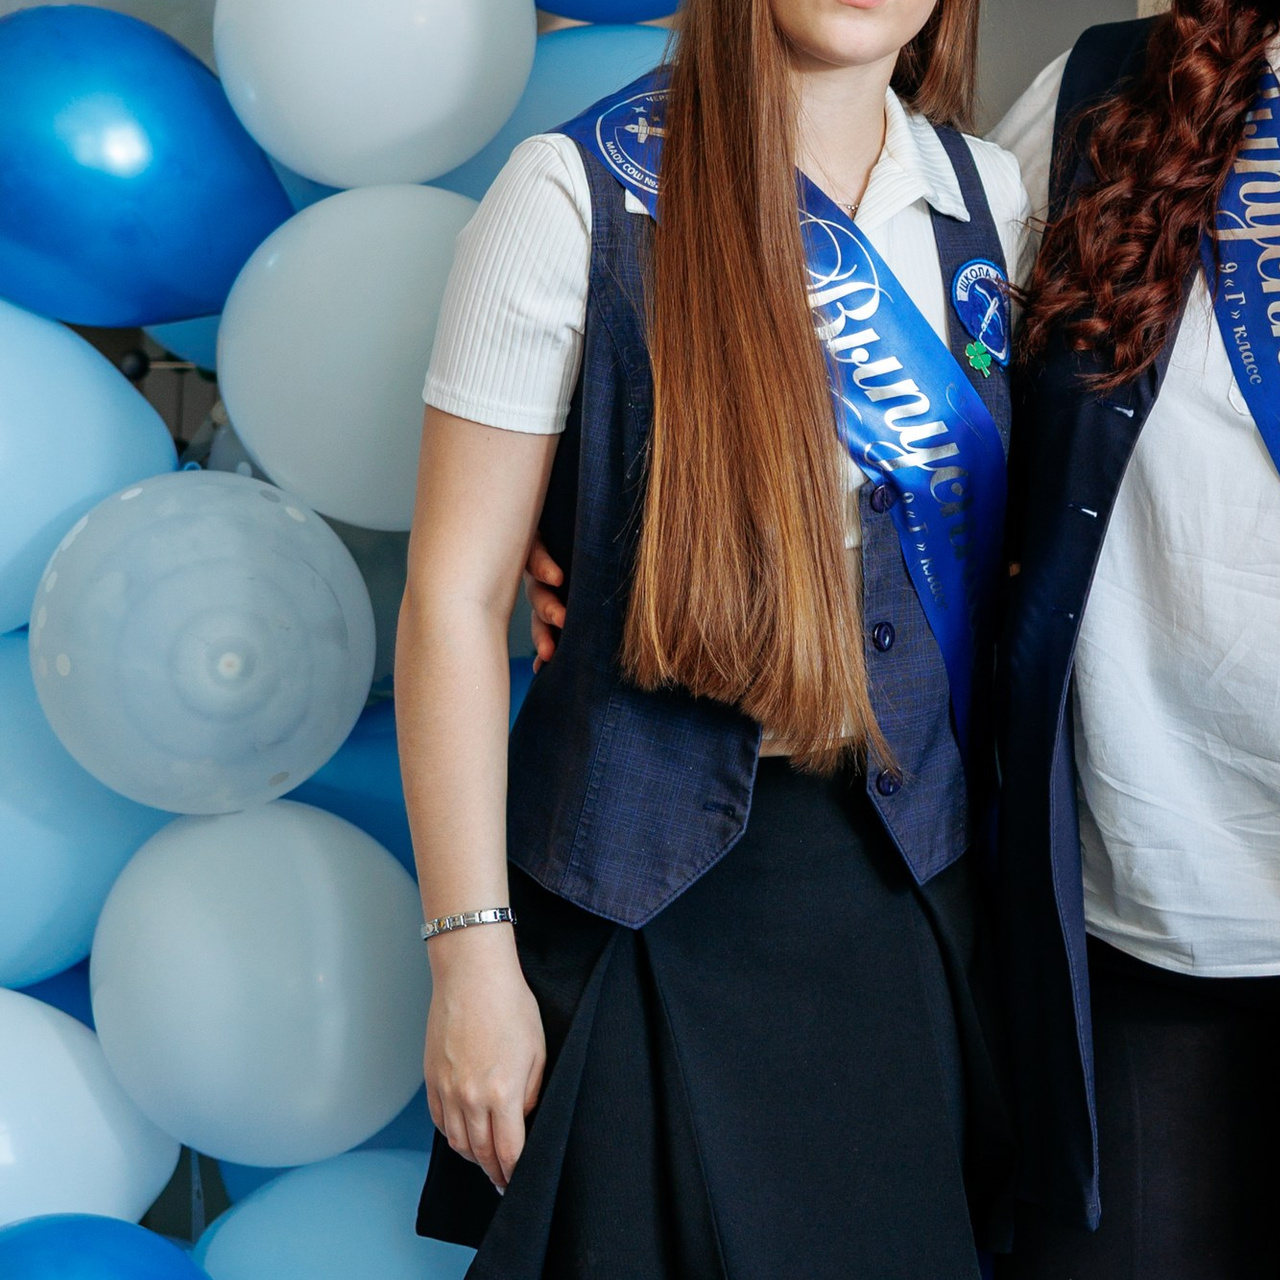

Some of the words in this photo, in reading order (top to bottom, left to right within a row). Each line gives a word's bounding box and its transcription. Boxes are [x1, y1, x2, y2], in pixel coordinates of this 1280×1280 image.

[605, 141, 626, 165] МАОУ
[622, 163, 644, 181] СОШ
[958, 266, 992, 293] ШКОЛА
[1219, 261, 1238, 274] 9
[1232, 324, 1263, 386] класс
